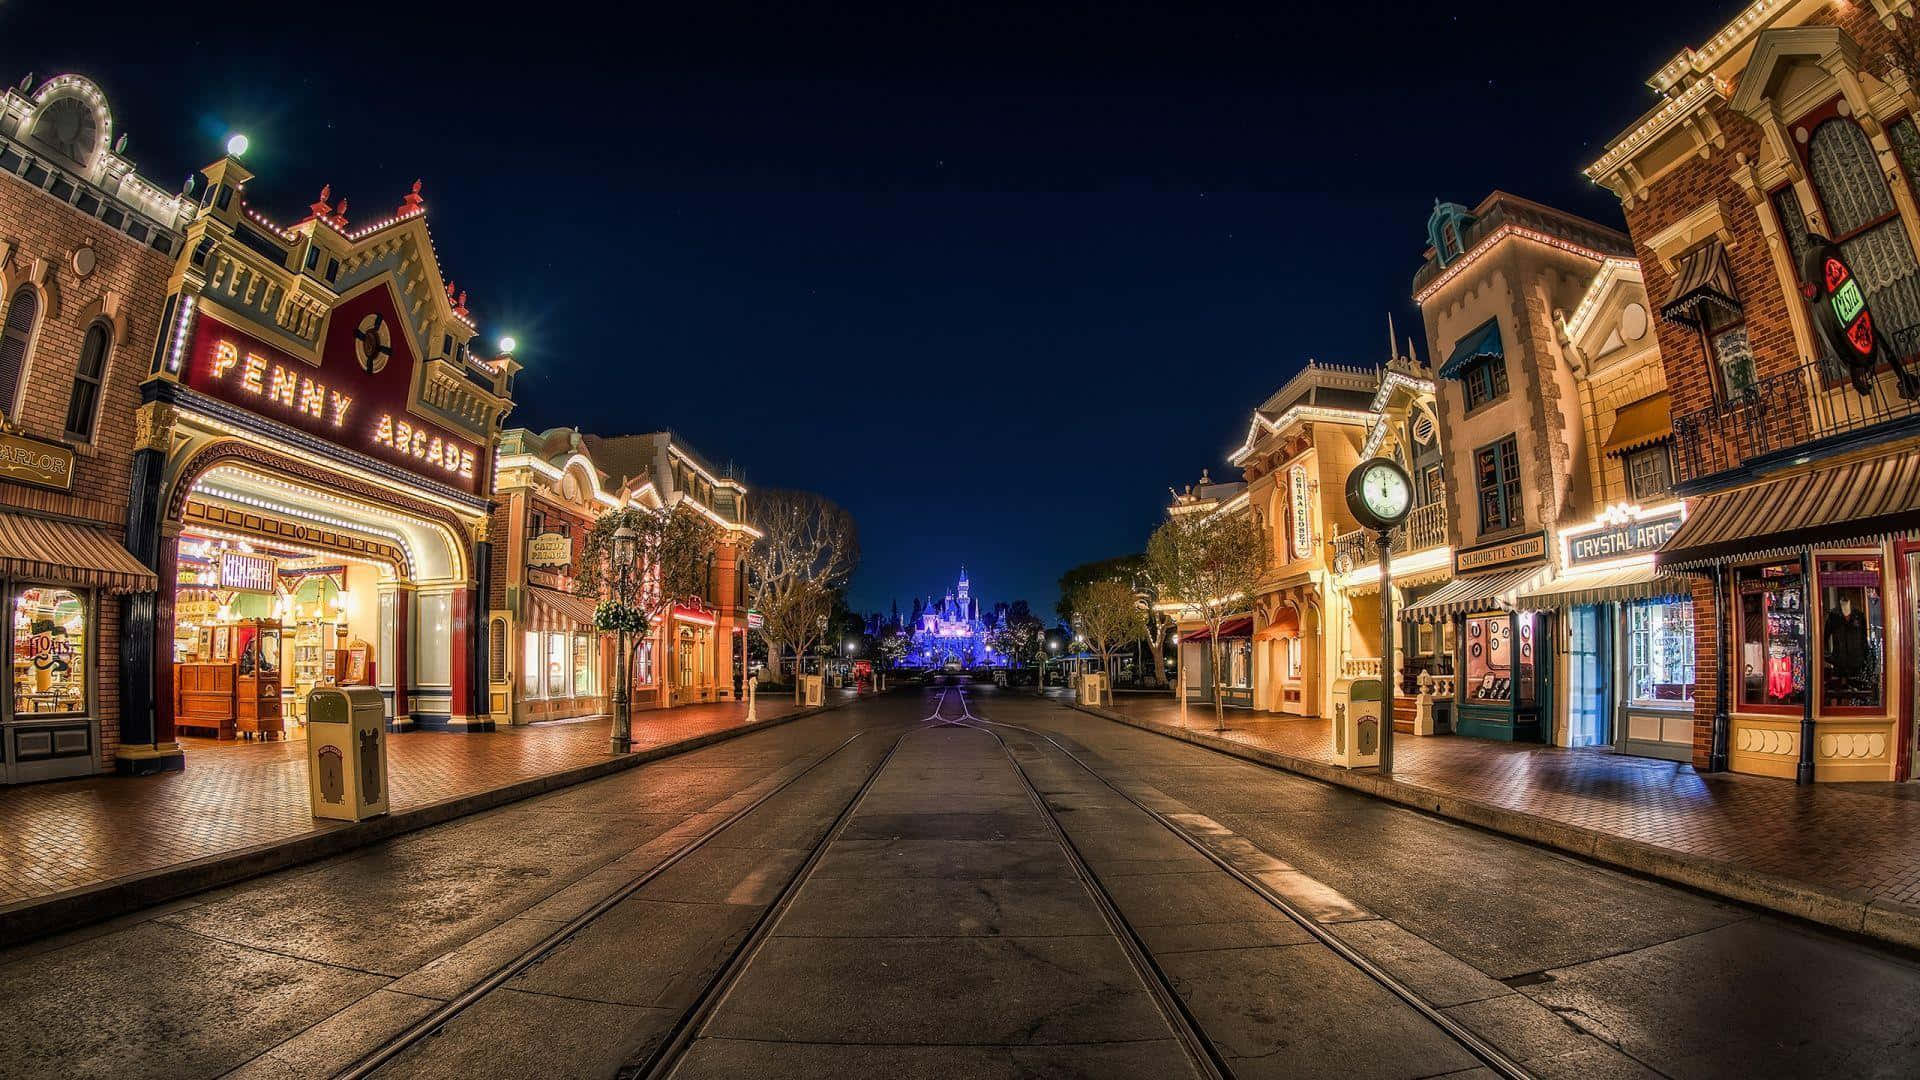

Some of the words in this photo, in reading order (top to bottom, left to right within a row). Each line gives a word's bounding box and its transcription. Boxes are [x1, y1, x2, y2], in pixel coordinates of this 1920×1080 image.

[209, 339, 352, 428] PENNY
[374, 413, 475, 480] ARCADE
[0, 443, 66, 475] ARLOR
[1295, 476, 1304, 507] CHINA
[1297, 509, 1306, 547] CLOSET
[1575, 531, 1634, 559] CRYSTAL
[1637, 522, 1674, 548] ARTS
[1462, 548, 1507, 567] SILHOUETTE
[1511, 540, 1539, 557] STUDIO
